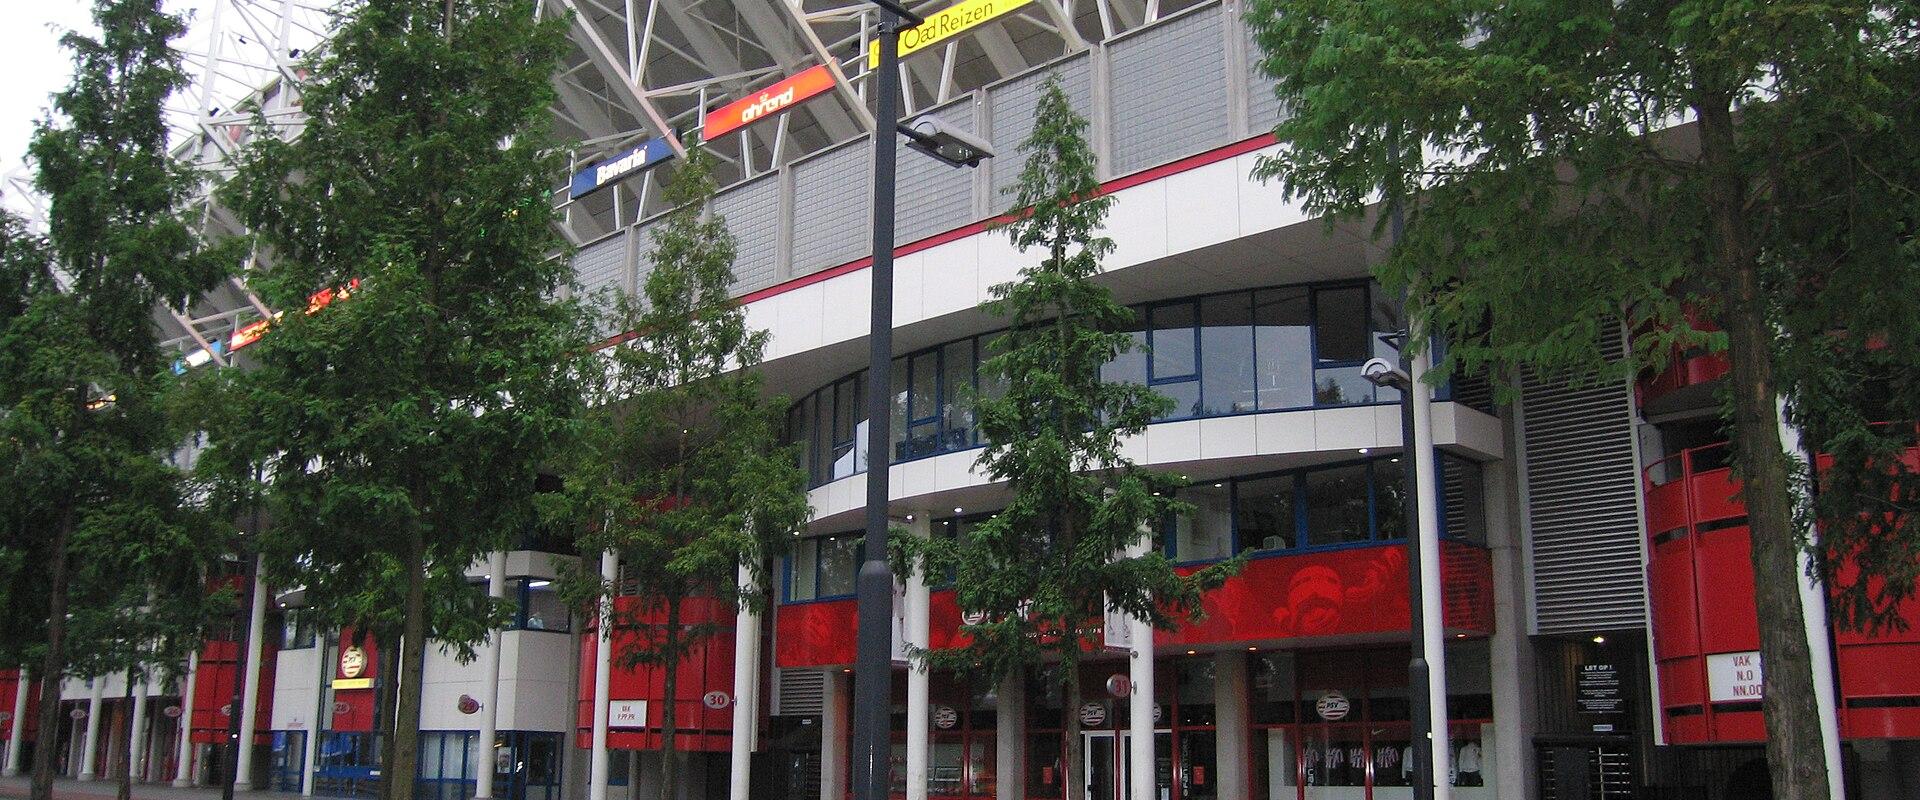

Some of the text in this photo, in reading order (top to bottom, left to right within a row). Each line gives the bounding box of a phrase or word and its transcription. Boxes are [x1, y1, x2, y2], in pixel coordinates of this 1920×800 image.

[940, 3, 993, 36] Reizen
[741, 87, 794, 123] ahrend
[596, 147, 647, 186] Bavaria
[1733, 655, 1751, 667] VAK
[709, 695, 724, 705] 30
